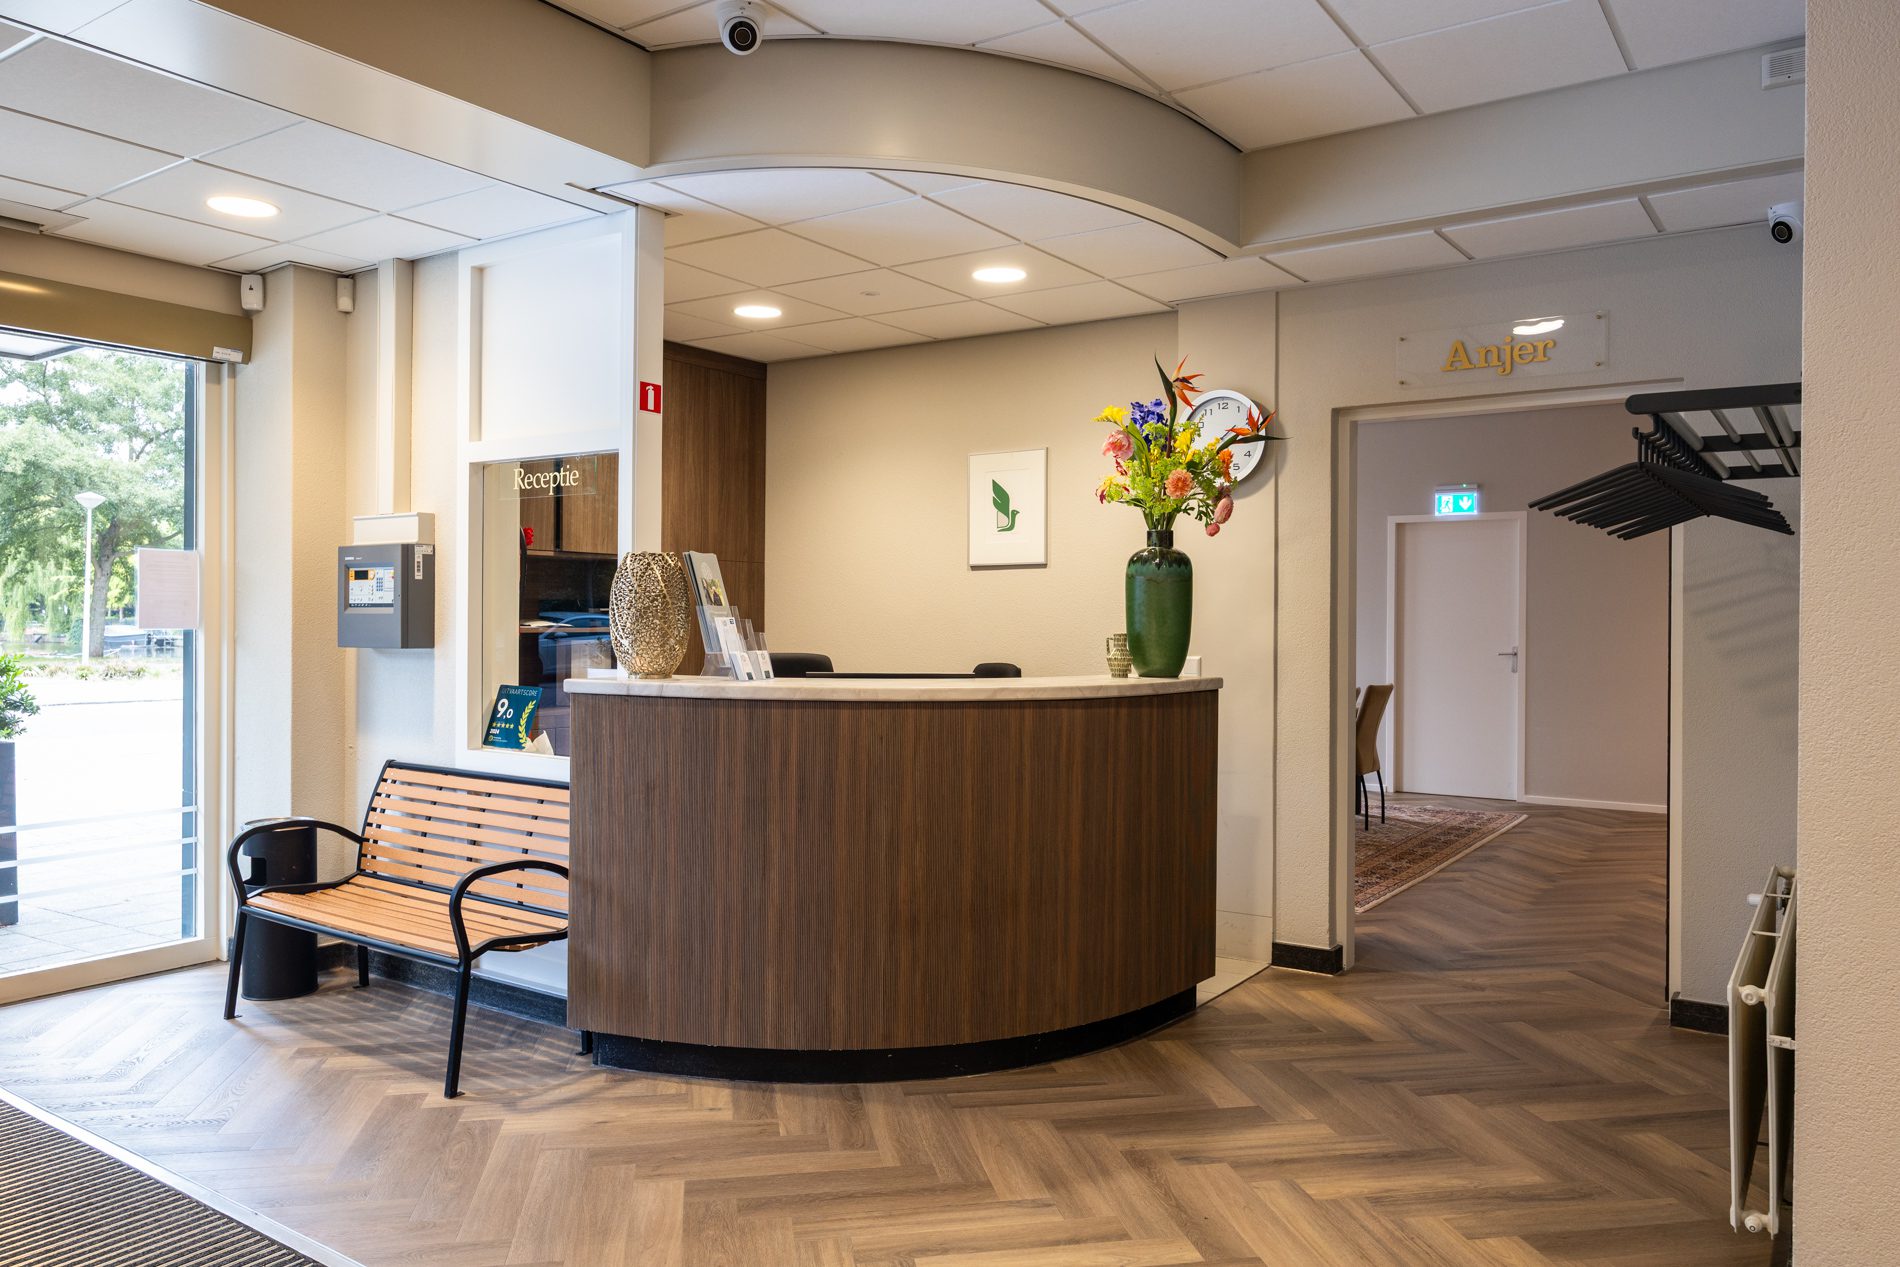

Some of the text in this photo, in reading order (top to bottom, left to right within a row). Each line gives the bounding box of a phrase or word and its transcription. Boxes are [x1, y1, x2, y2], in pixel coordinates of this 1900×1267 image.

[1440, 336, 1555, 375] Anjer
[1217, 402, 1229, 410] 12
[1204, 408, 1213, 416] 11
[1243, 450, 1252, 458] 4
[1233, 463, 1241, 471] 5
[513, 464, 579, 496] Receptie
[496, 698, 514, 719] 9,0
